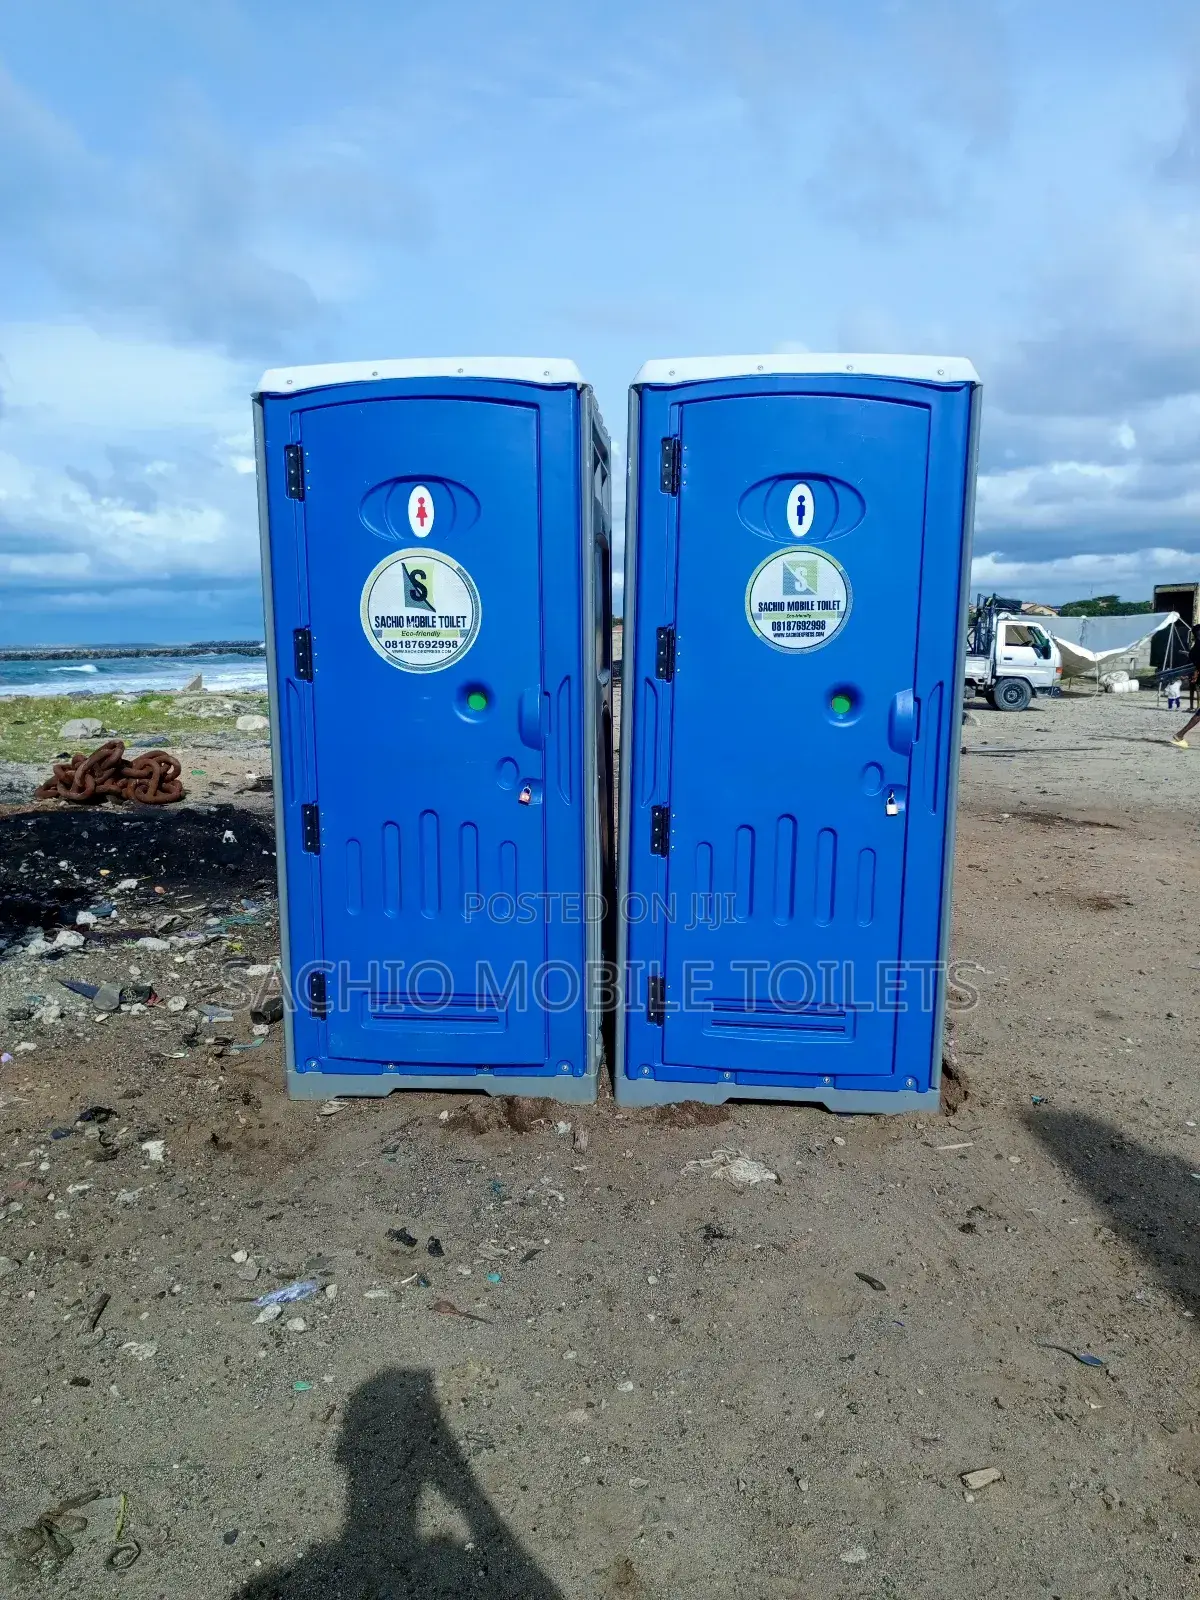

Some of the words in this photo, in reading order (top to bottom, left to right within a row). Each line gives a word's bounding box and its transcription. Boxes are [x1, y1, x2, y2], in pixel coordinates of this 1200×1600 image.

[410, 569, 428, 601] S
[758, 601, 785, 613] SACHIO
[787, 600, 815, 612] MOBILE
[816, 600, 841, 611] TOILET
[374, 615, 405, 628] SACHIO
[406, 615, 437, 628] MOBILE
[438, 615, 467, 628] TOILET
[771, 620, 826, 632] 08187692998
[401, 630, 441, 638] Eco-friendly
[384, 640, 459, 649] 08187692998
